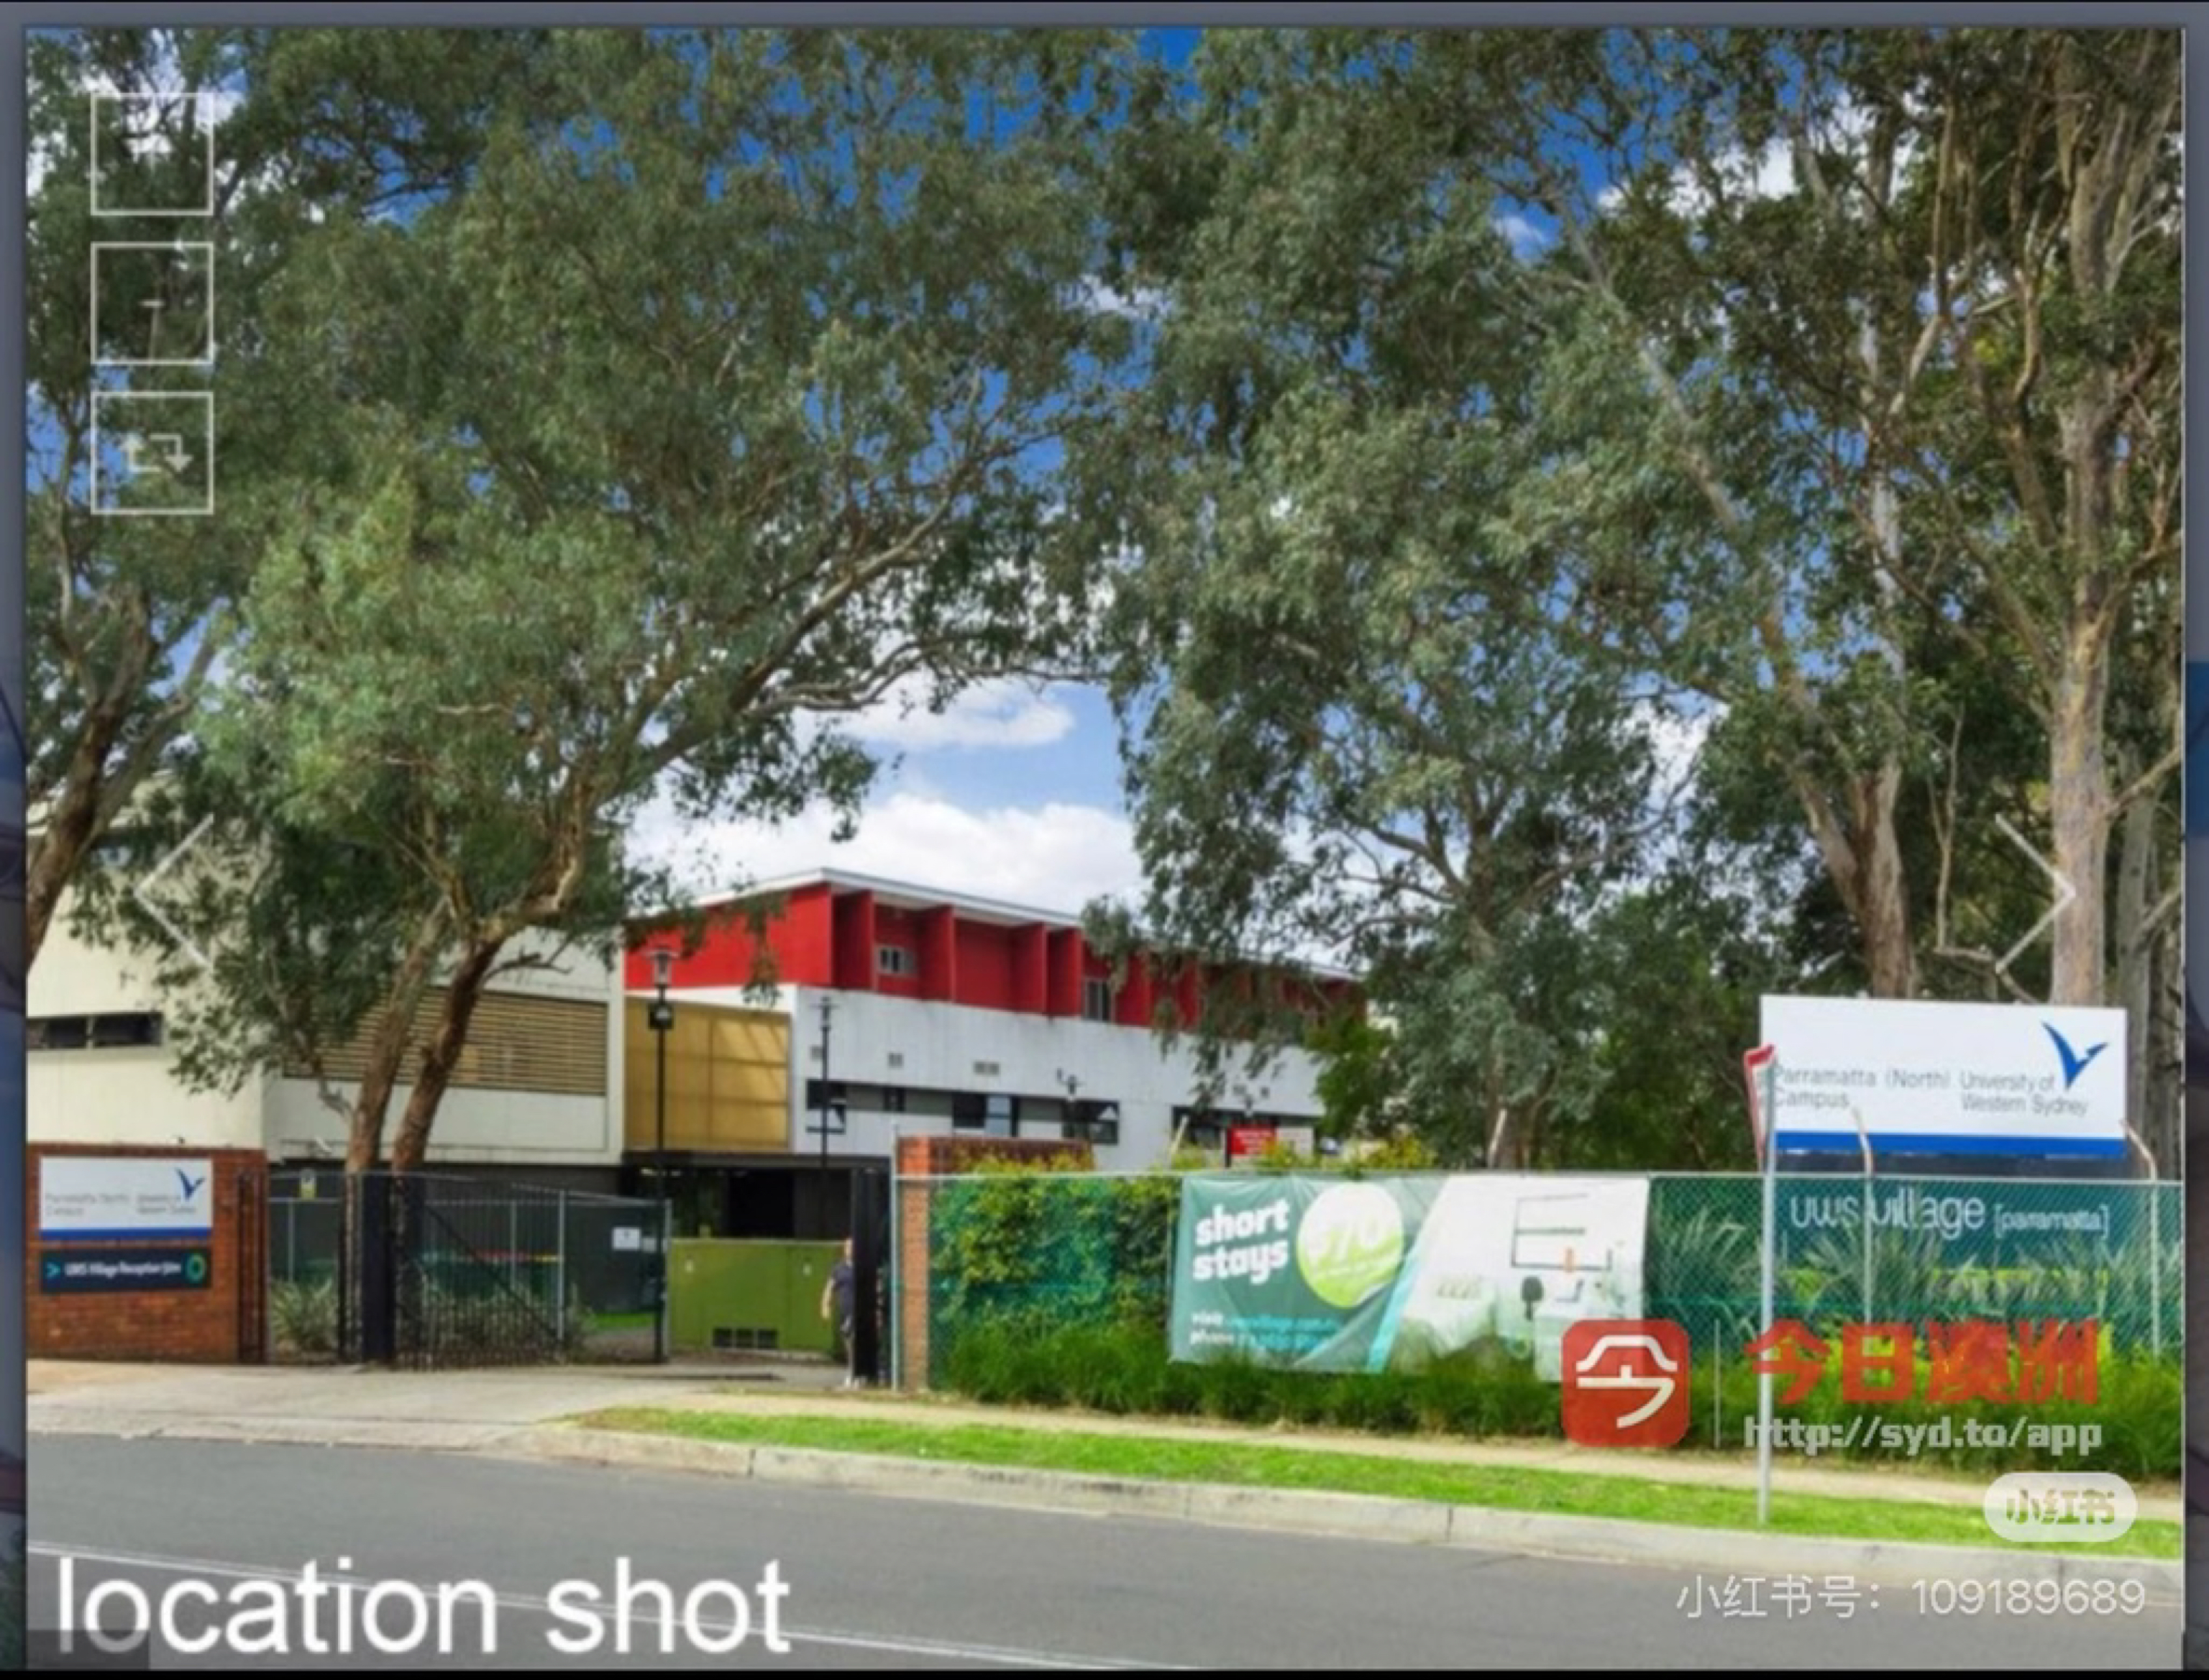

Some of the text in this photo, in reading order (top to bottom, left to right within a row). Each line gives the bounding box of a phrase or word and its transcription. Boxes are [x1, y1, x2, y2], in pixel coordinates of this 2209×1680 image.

[1885, 1069, 1951, 1089] (North)
[1961, 1070, 2055, 1093] University of
[1961, 1092, 2087, 1117] Western Sydney
[1194, 1198, 1289, 1246] short
[1871, 1187, 1986, 1240] village
[1192, 1238, 1289, 1285] stays
